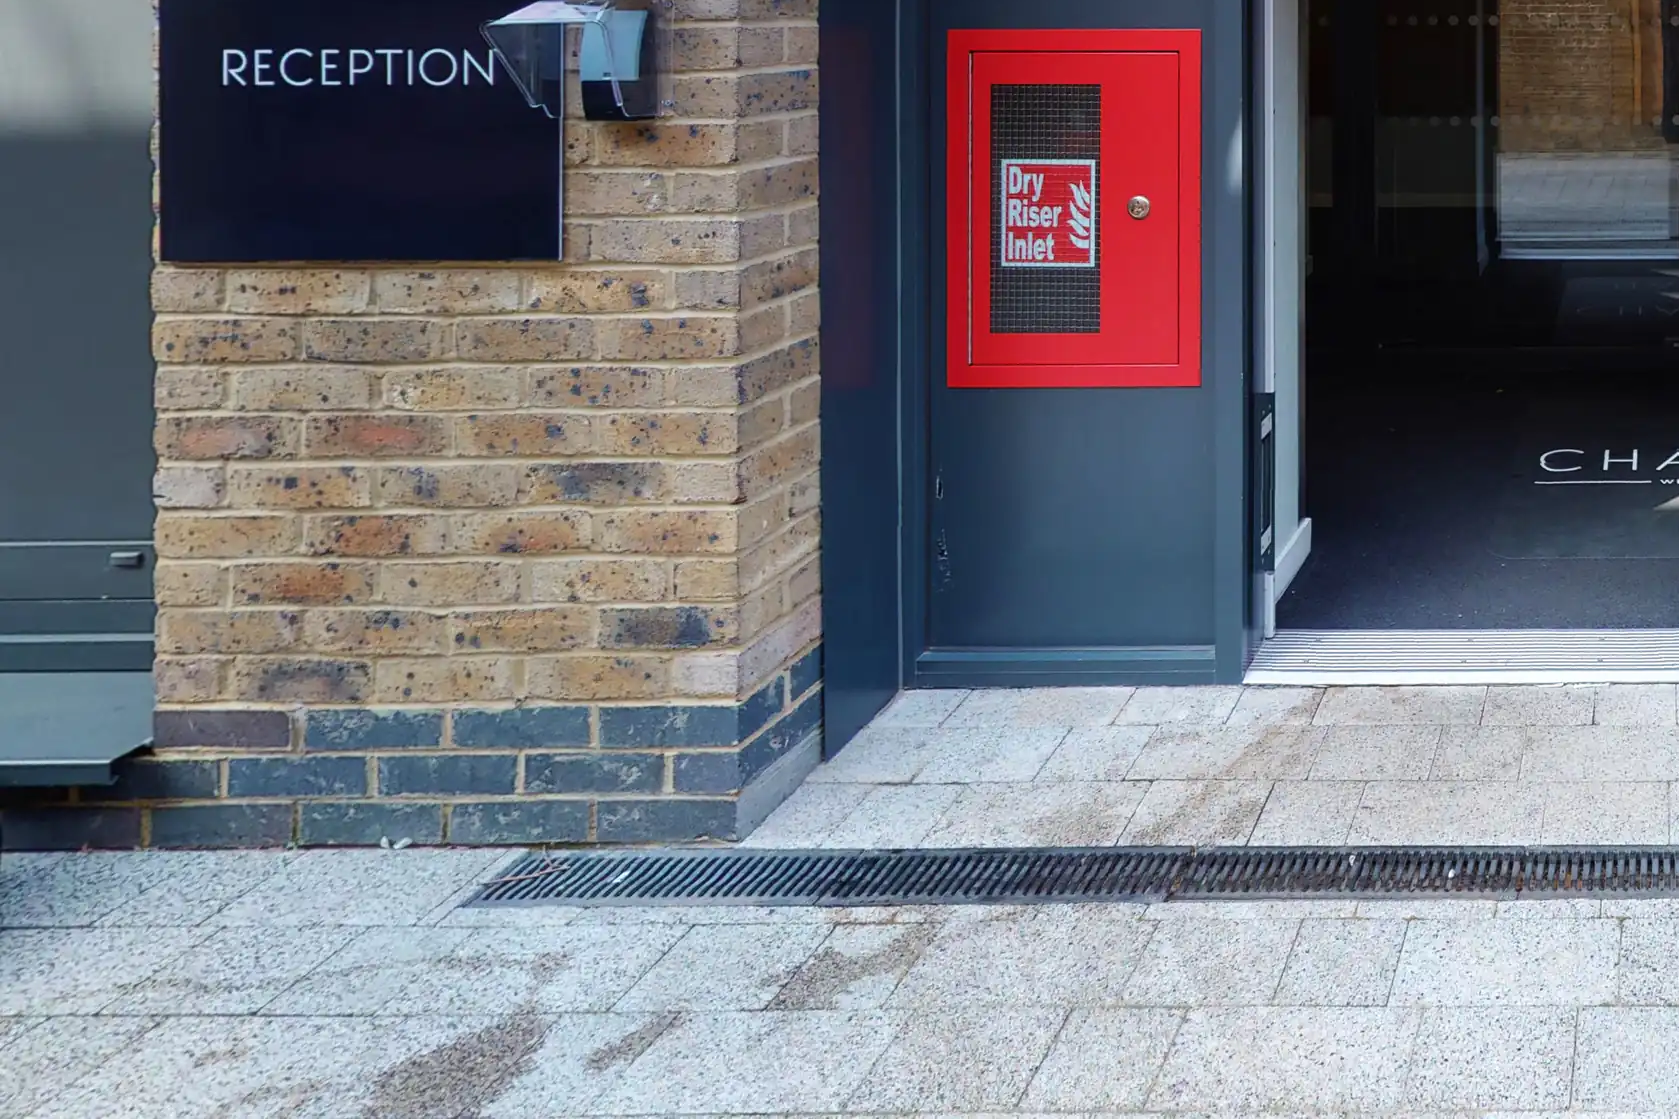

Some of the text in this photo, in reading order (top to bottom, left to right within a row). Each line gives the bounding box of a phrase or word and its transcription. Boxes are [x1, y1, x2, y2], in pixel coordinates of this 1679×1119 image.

[222, 47, 496, 86] RECEPTION
[1008, 166, 1045, 202] Dry
[1007, 198, 1063, 228] Riser
[1007, 231, 1056, 261] Inlet
